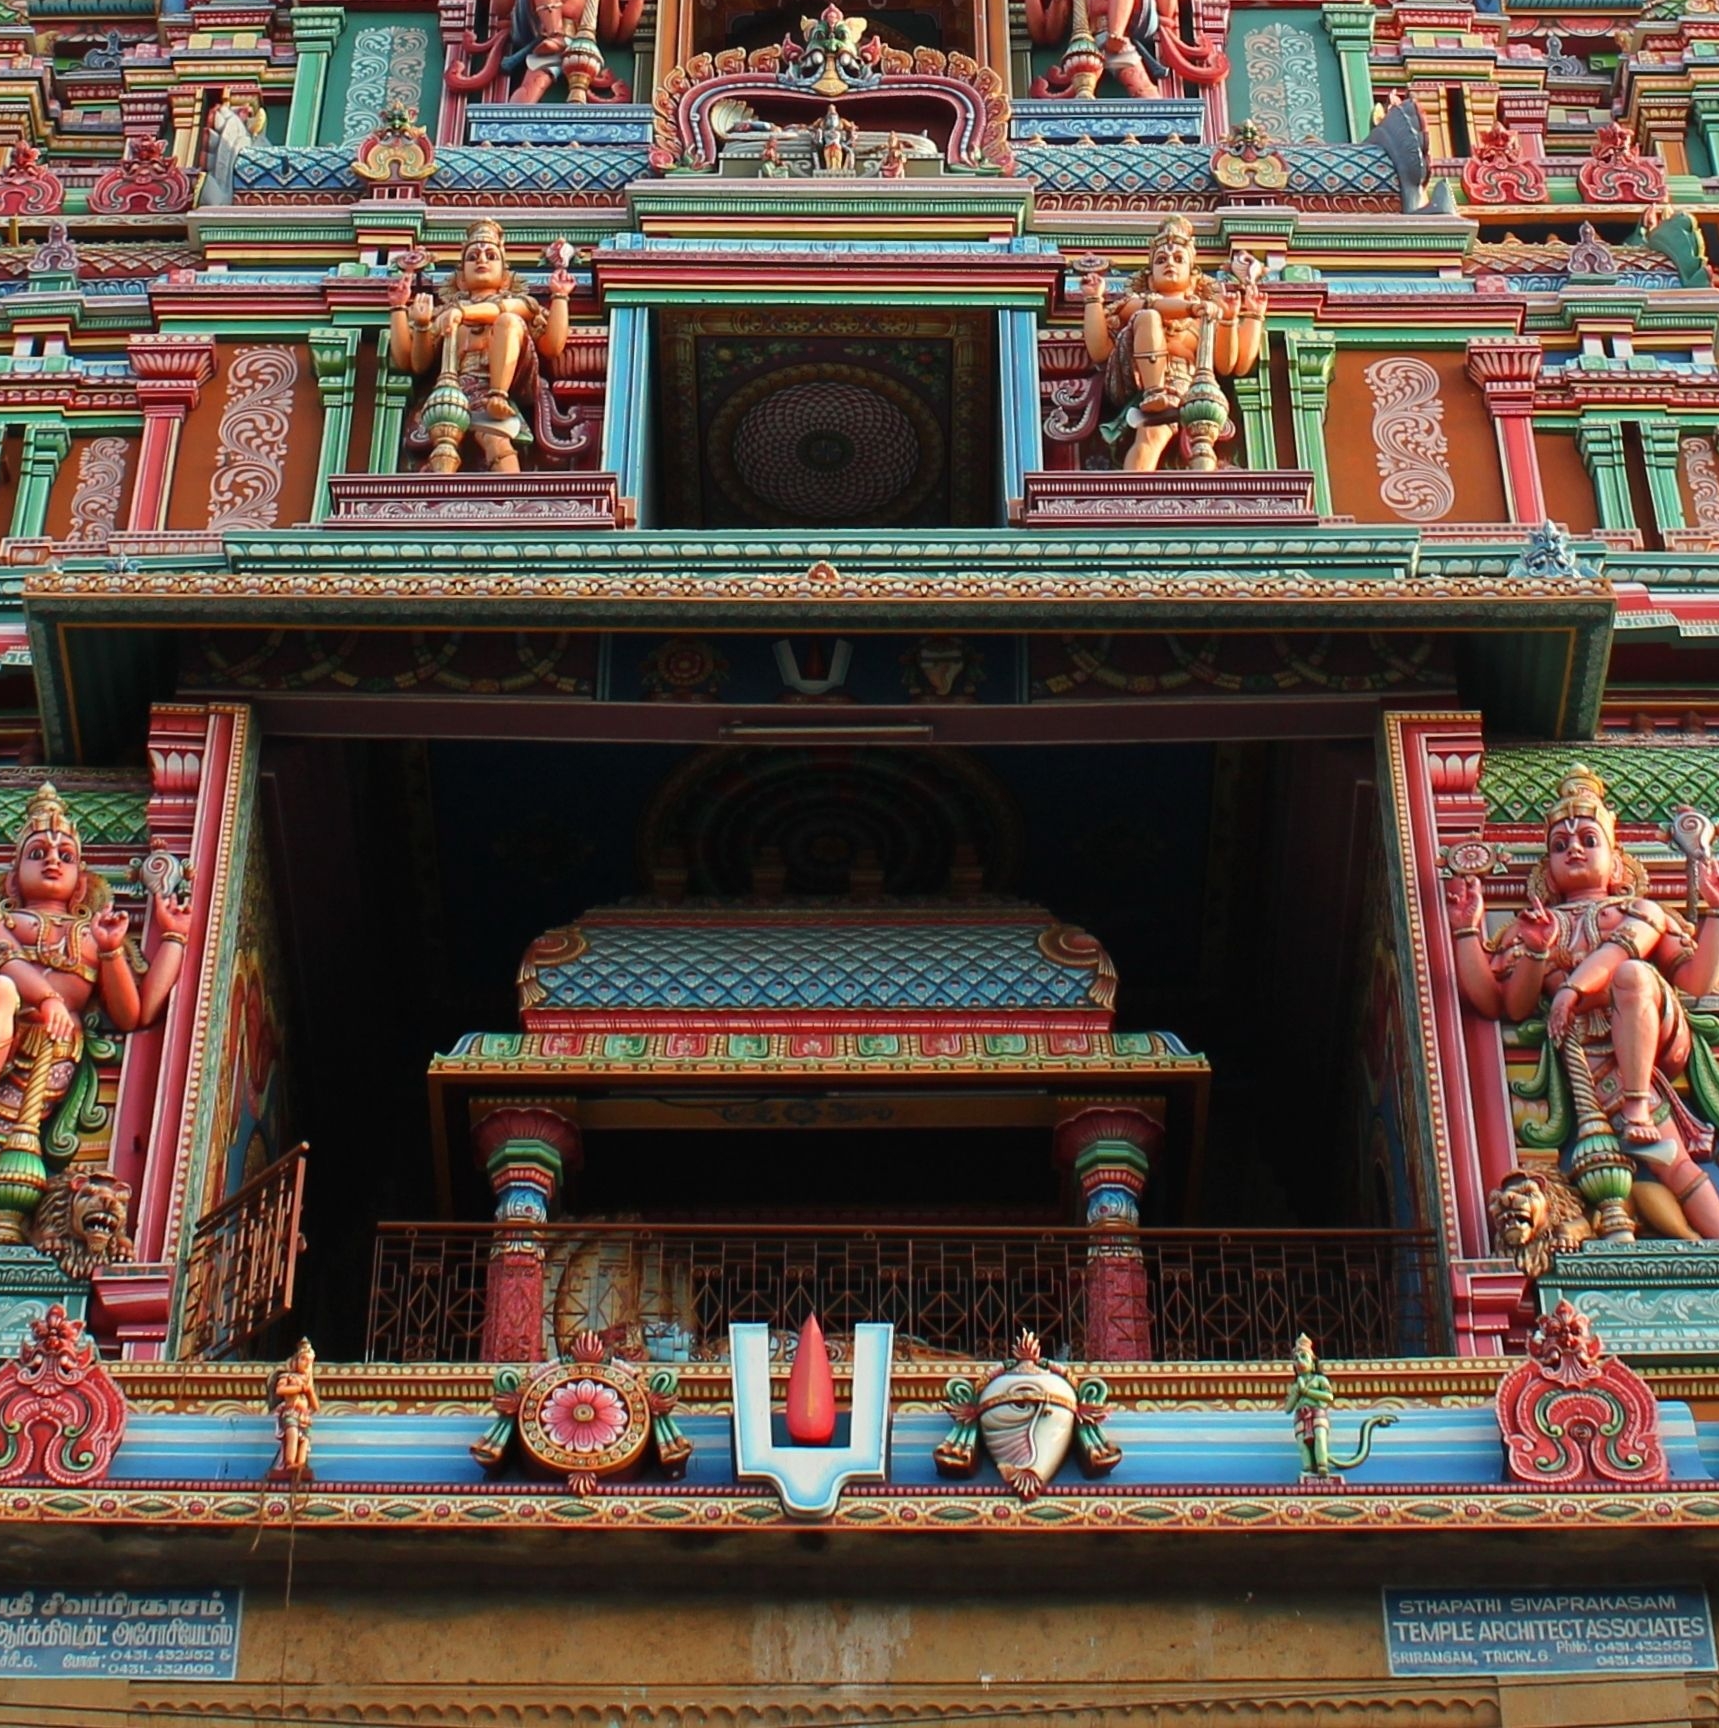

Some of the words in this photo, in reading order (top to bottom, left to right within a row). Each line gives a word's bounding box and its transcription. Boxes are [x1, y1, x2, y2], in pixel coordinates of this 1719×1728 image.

[1398, 1598, 1502, 1614] STHAPATHI
[1509, 1595, 1677, 1613] SIVAPRAKASAM
[1393, 1620, 1475, 1643] TEMPLE
[1478, 1619, 1584, 1642] ARCHITECT
[1585, 1617, 1705, 1640] ASSOCIATES
